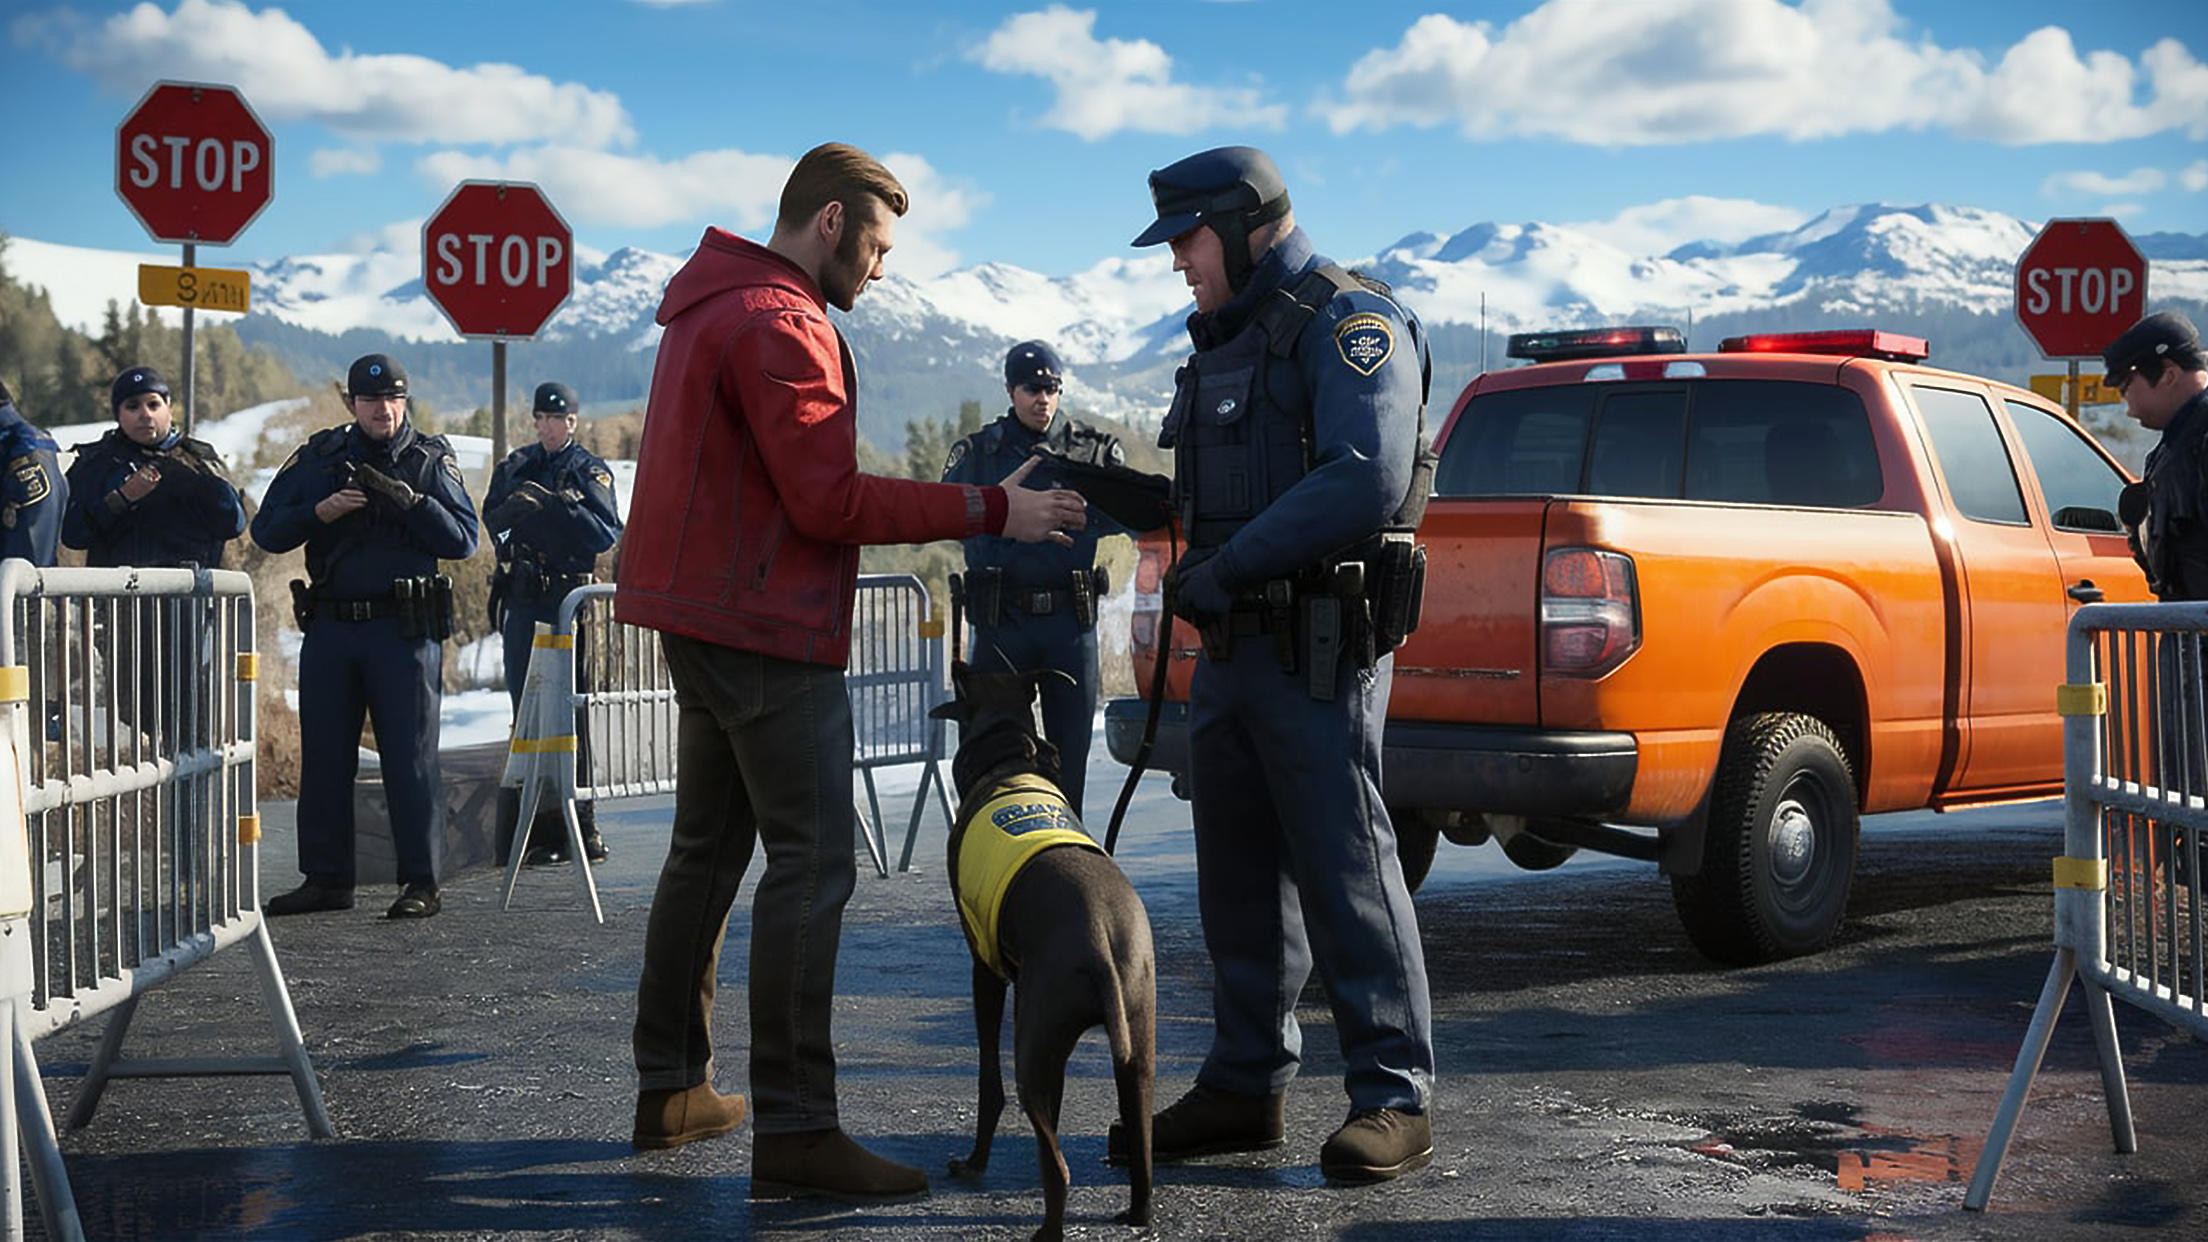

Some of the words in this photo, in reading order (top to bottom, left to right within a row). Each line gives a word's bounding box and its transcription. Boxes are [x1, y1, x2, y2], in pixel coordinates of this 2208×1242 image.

[131, 135, 259, 191] STOP
[437, 234, 562, 286] STOP
[2027, 268, 2133, 314] STOP
